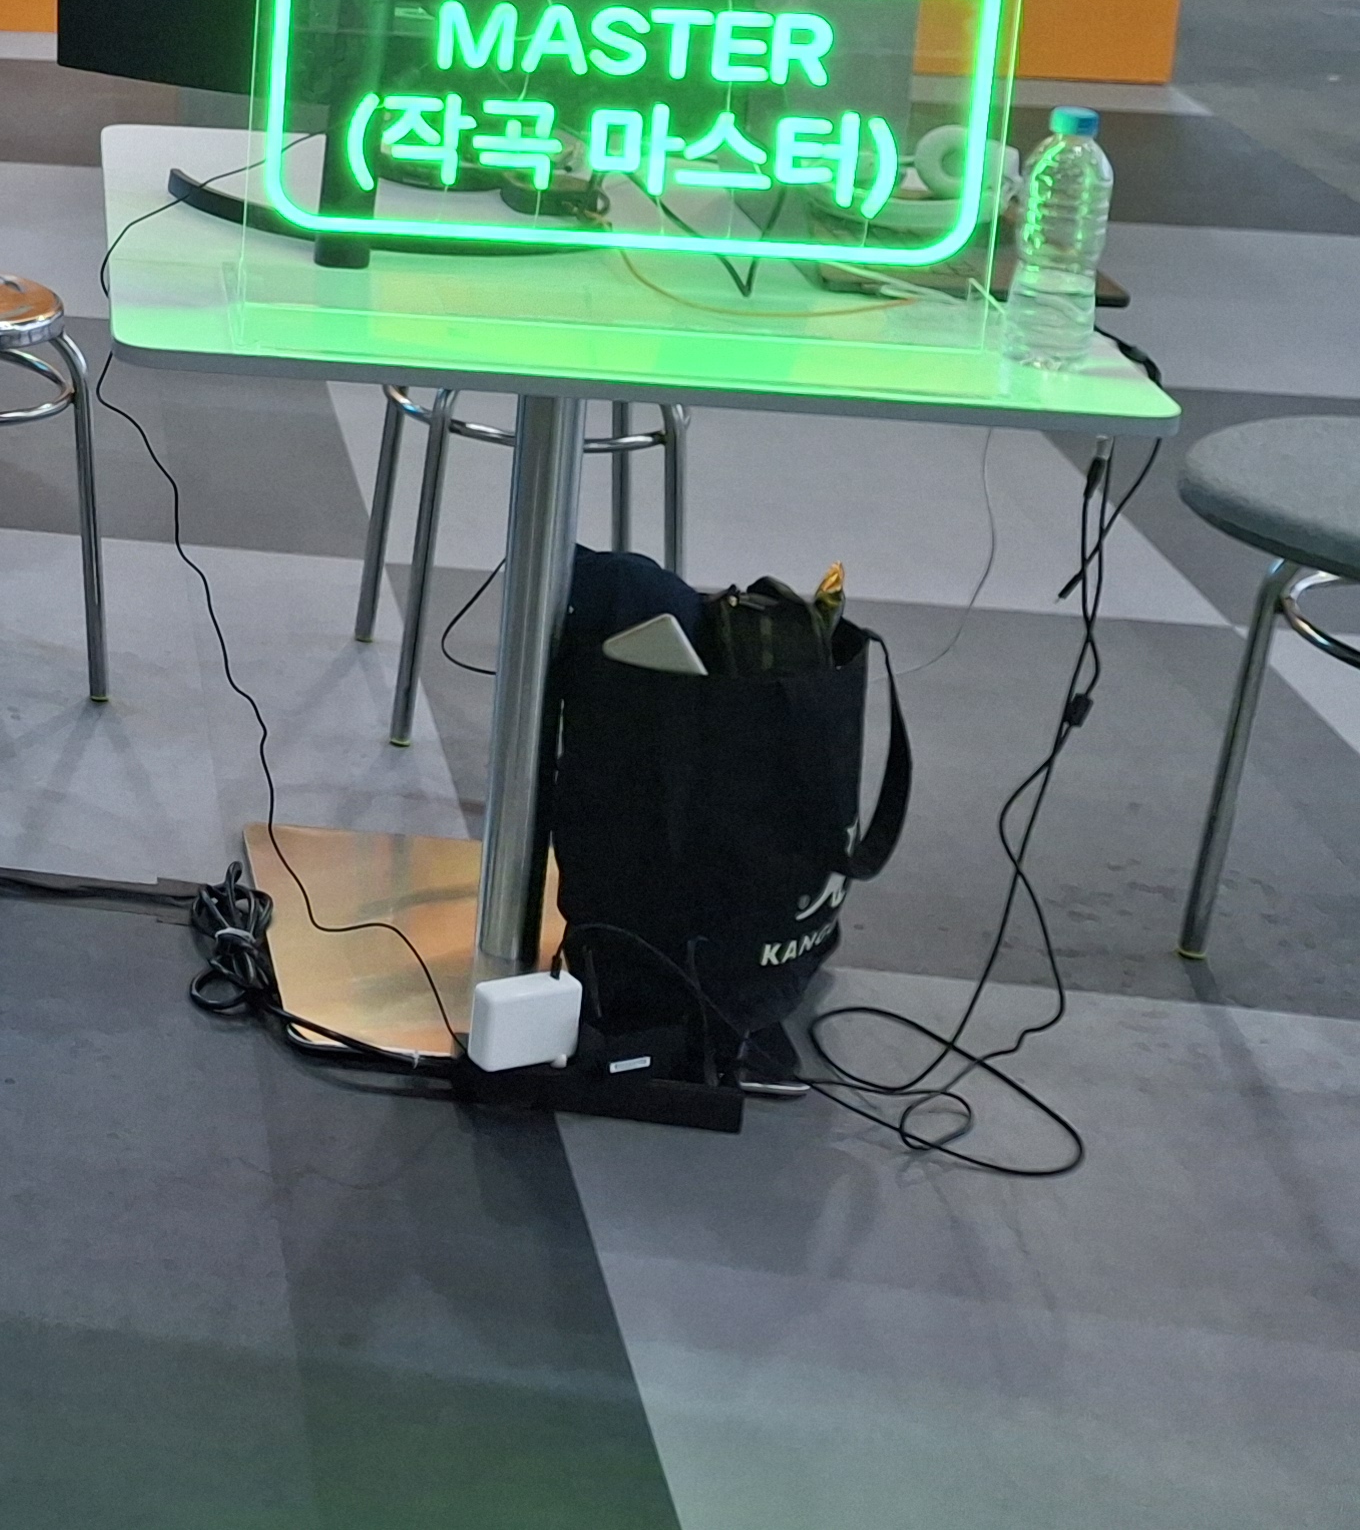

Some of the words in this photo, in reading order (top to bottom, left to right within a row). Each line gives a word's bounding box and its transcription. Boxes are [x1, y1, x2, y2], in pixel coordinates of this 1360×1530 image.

[435, 0, 835, 87] MASTER
[346, 92, 565, 192] (작곡
[588, 101, 900, 221] 마스터)
